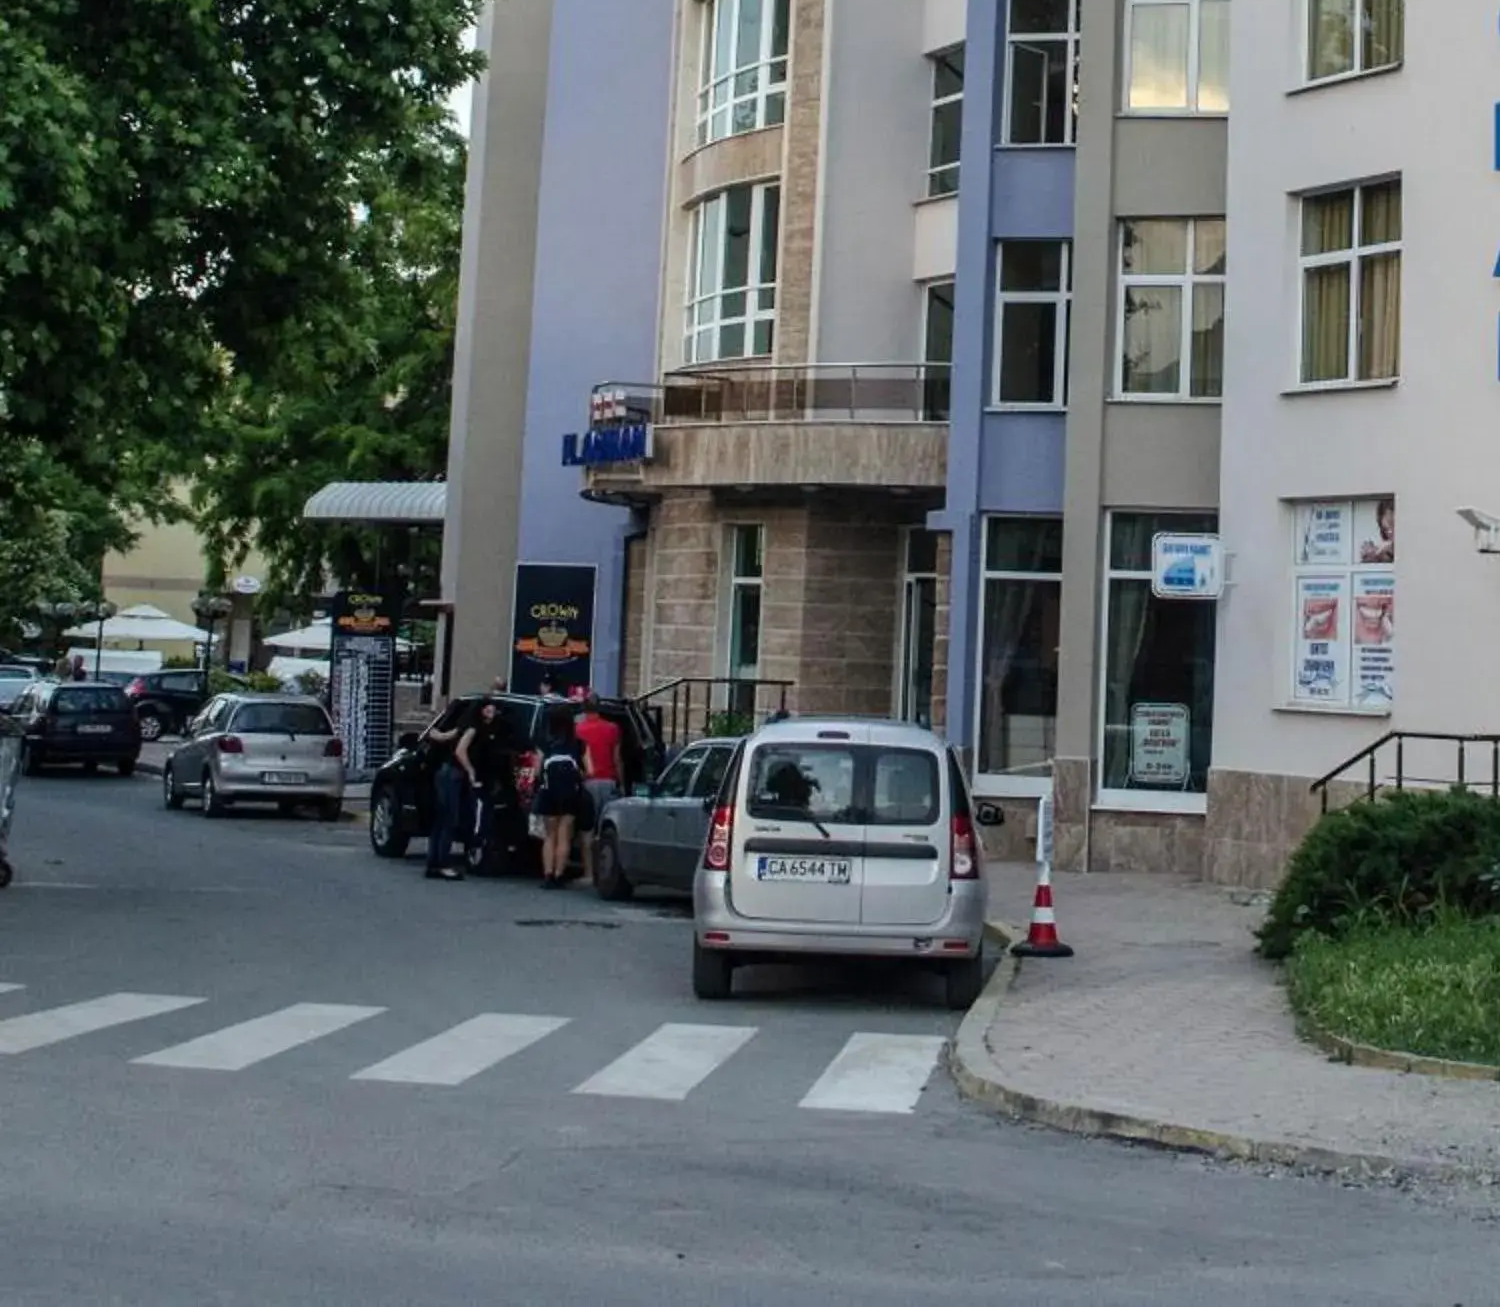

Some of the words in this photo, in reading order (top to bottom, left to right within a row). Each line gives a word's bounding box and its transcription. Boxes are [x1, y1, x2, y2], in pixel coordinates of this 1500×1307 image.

[530, 602, 579, 619] CROWN
[768, 859, 788, 875] CA
[790, 860, 826, 877] 6544
